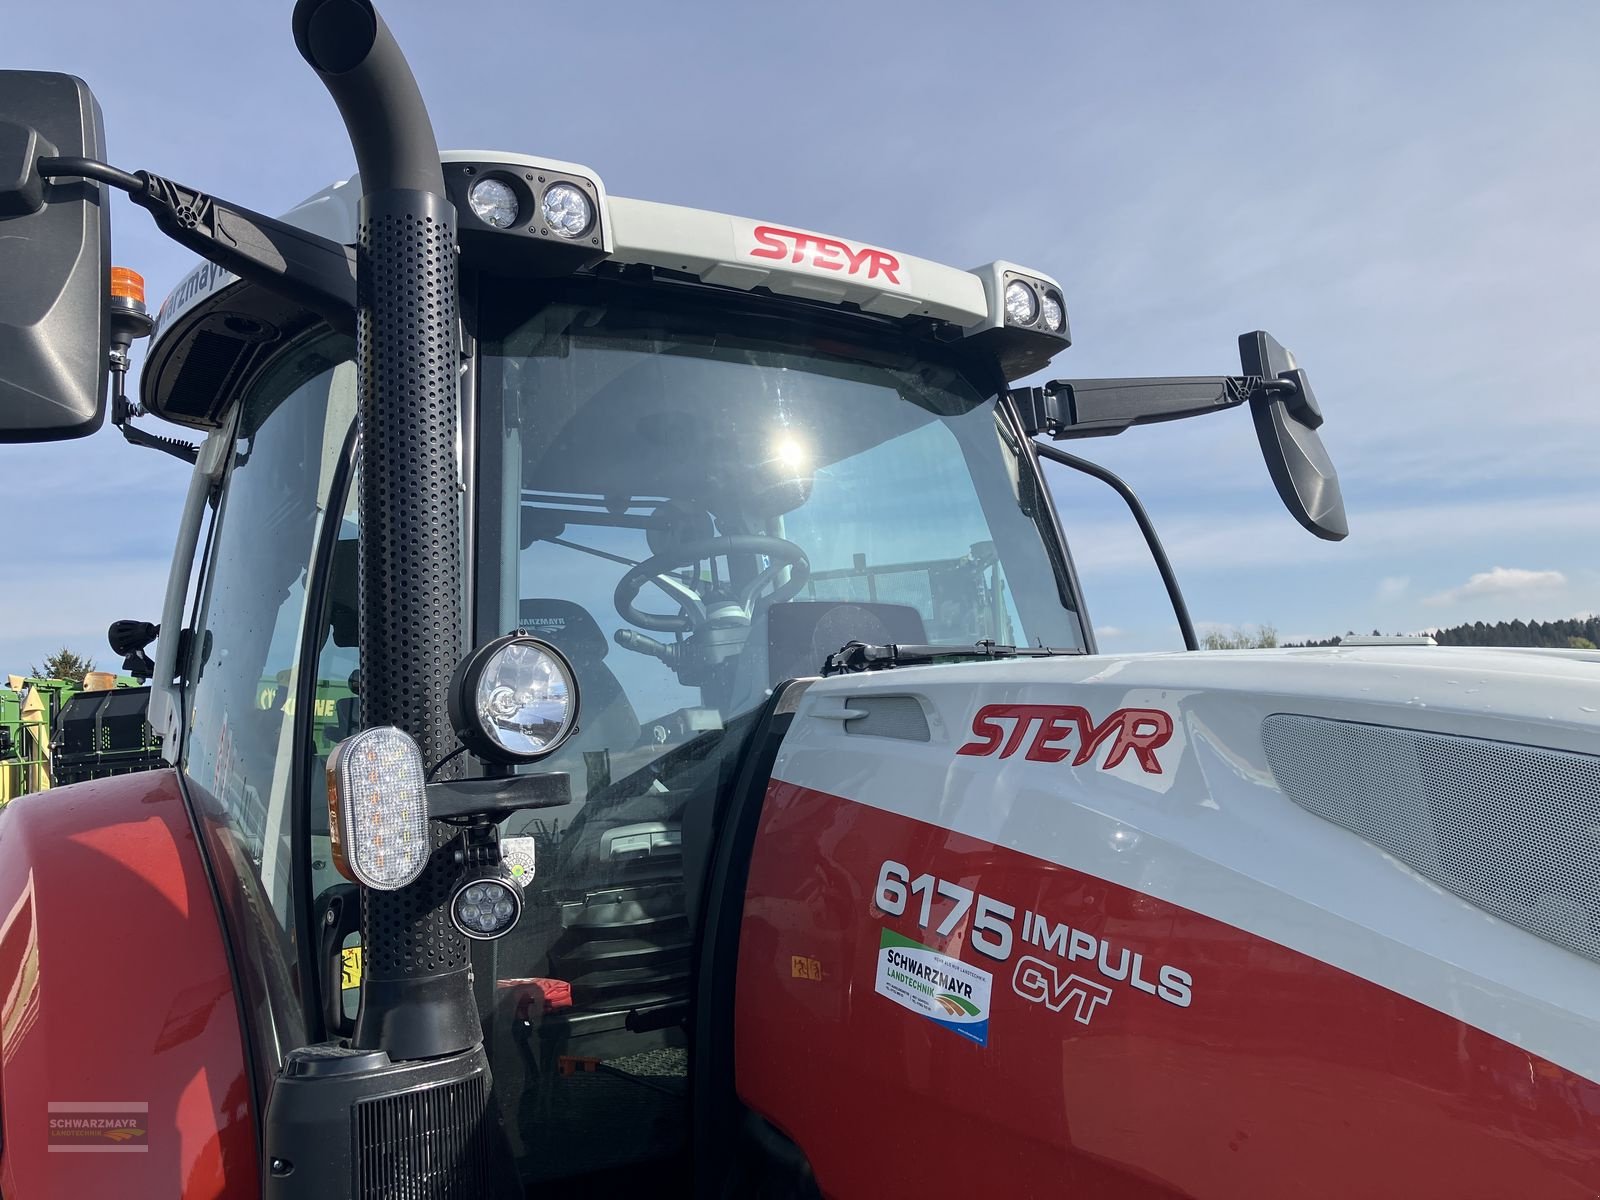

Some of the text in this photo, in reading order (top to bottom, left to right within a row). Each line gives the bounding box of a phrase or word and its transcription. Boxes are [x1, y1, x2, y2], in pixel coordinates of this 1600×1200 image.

[750, 226, 901, 285] STEYR
[956, 704, 1173, 774] STEYR
[874, 859, 1015, 961] 6175
[887, 949, 973, 999] SCHWARZMAYR
[887, 967, 935, 998] LANDTECHNIK
[1011, 955, 1113, 1025] CVT
[1021, 909, 1193, 1008] IMPULS
